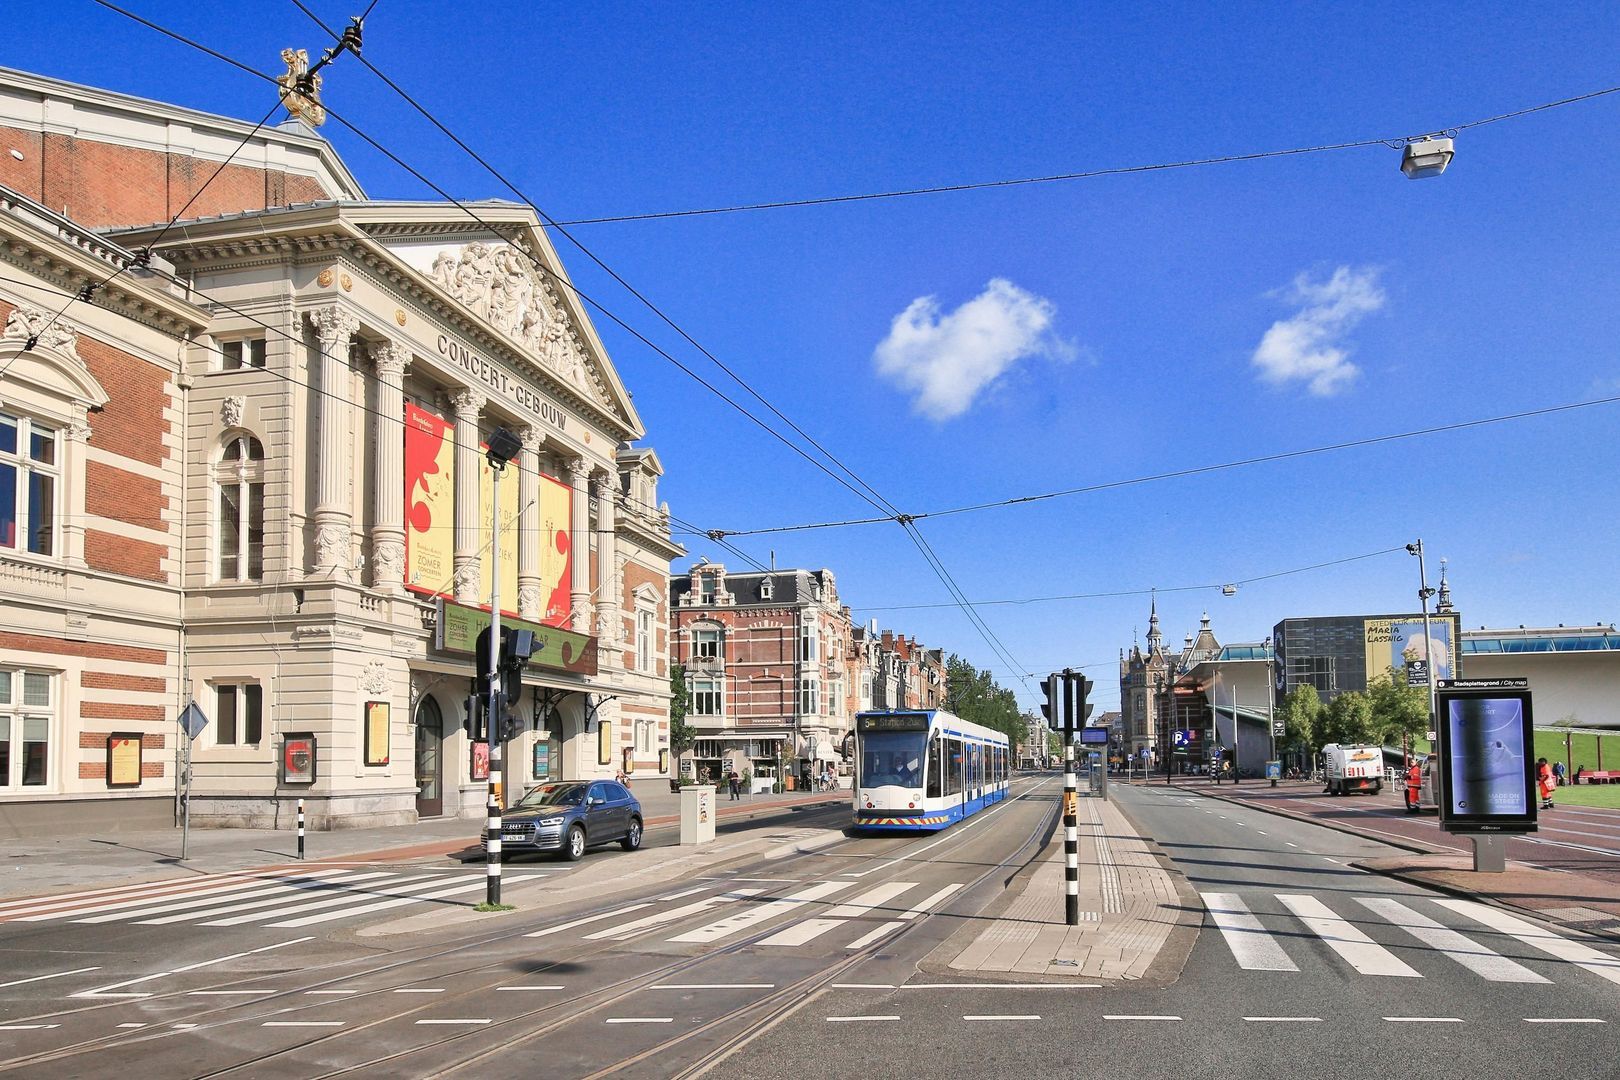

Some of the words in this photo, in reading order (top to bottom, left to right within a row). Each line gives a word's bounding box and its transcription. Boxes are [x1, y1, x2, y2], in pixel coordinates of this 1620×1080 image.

[485, 545, 512, 561] MZIEK
[418, 555, 441, 570] ZOMER
[450, 622, 468, 632] ZOMER
[864, 718, 870, 728] 5
